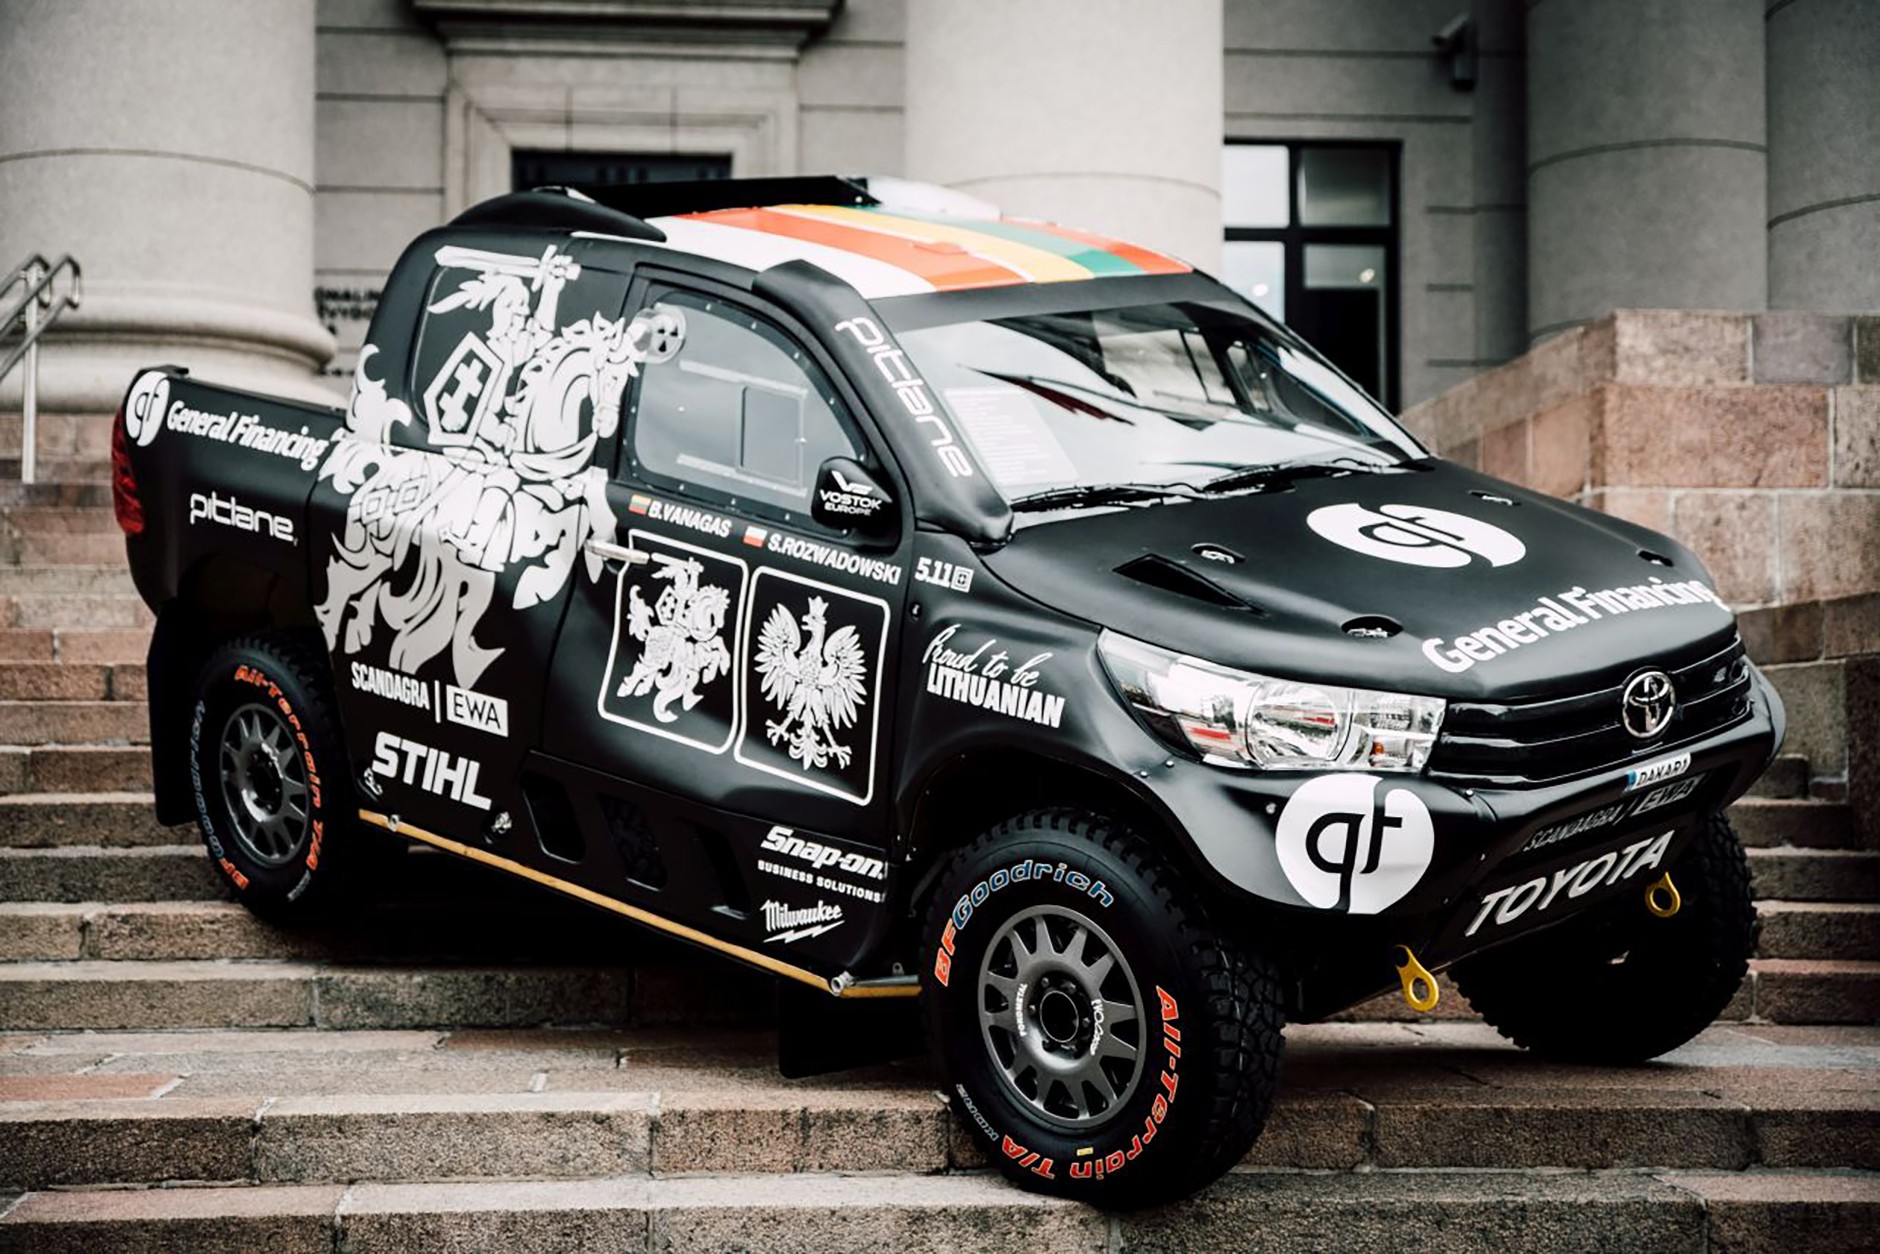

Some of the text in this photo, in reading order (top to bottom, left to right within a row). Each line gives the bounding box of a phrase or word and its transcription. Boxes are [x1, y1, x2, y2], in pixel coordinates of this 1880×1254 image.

[835, 317, 974, 478] pitlane
[167, 400, 329, 471] General Financing
[190, 491, 295, 542] pitlane
[648, 501, 732, 538] B.VANAGAS
[820, 489, 882, 510] VOSTOK
[824, 501, 872, 516] EUROPE
[767, 532, 902, 585] S.ROZWADOWSKI
[922, 624, 1053, 687] Proud to be
[1421, 597, 1578, 673] General
[351, 661, 501, 729] SCANDAGRA EWA
[926, 662, 1066, 728] LITHUANIAN
[371, 731, 492, 811] STIHL
[757, 859, 886, 903] BUSINESS SOLUTIONS
[1465, 830, 1676, 938] TOYOTA
[760, 899, 843, 932] Milwaukee
[934, 860, 1114, 987] BFGoodrich
[1070, 985, 1181, 1180] All-Terrain
[1002, 1134, 1055, 1180] T/A
